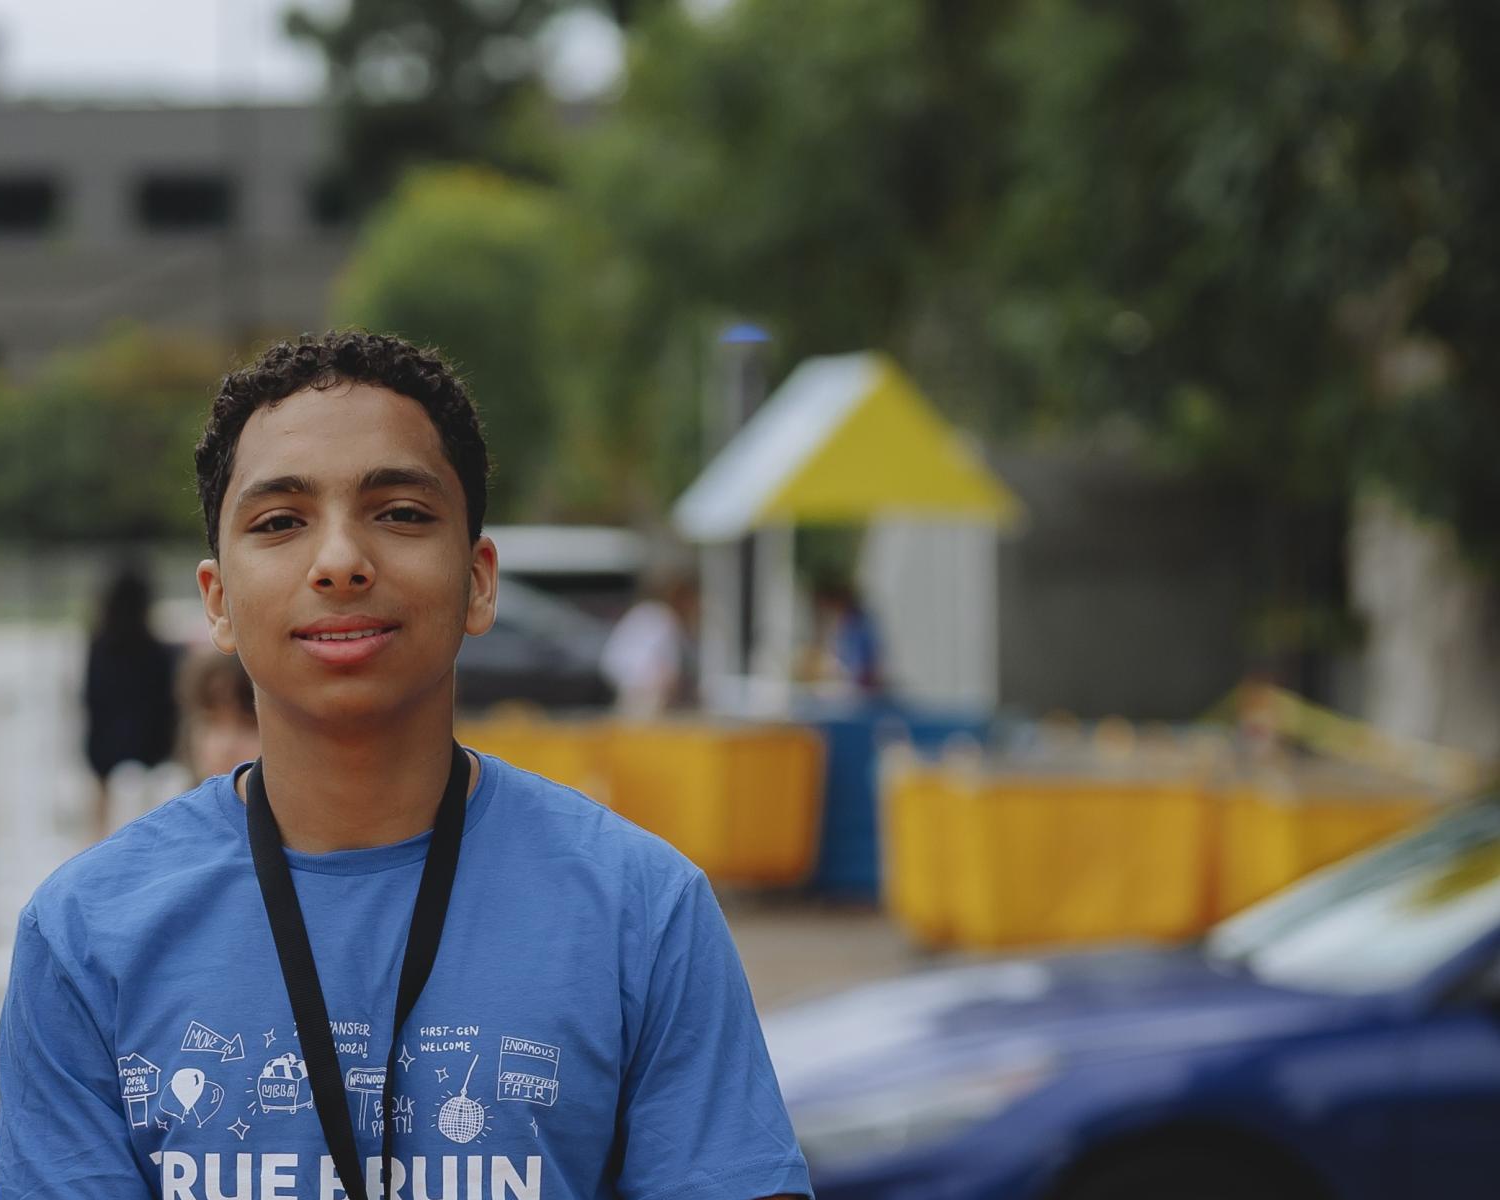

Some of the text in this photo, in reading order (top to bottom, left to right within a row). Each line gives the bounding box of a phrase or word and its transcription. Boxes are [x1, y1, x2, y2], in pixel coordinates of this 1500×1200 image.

[420, 1025, 479, 1037] FIRST-GEN
[186, 1029, 236, 1055] MOVE IN
[420, 1041, 472, 1053] WELCOME
[504, 1040, 556, 1059] ENORMOUS
[126, 1076, 146, 1086] OPEN
[123, 1083, 150, 1096] HOUSE
[262, 1084, 296, 1099] UCLA
[504, 1083, 546, 1100] FAIR
[373, 1094, 416, 1119] BOCK
[371, 1114, 414, 1138] PATY!
